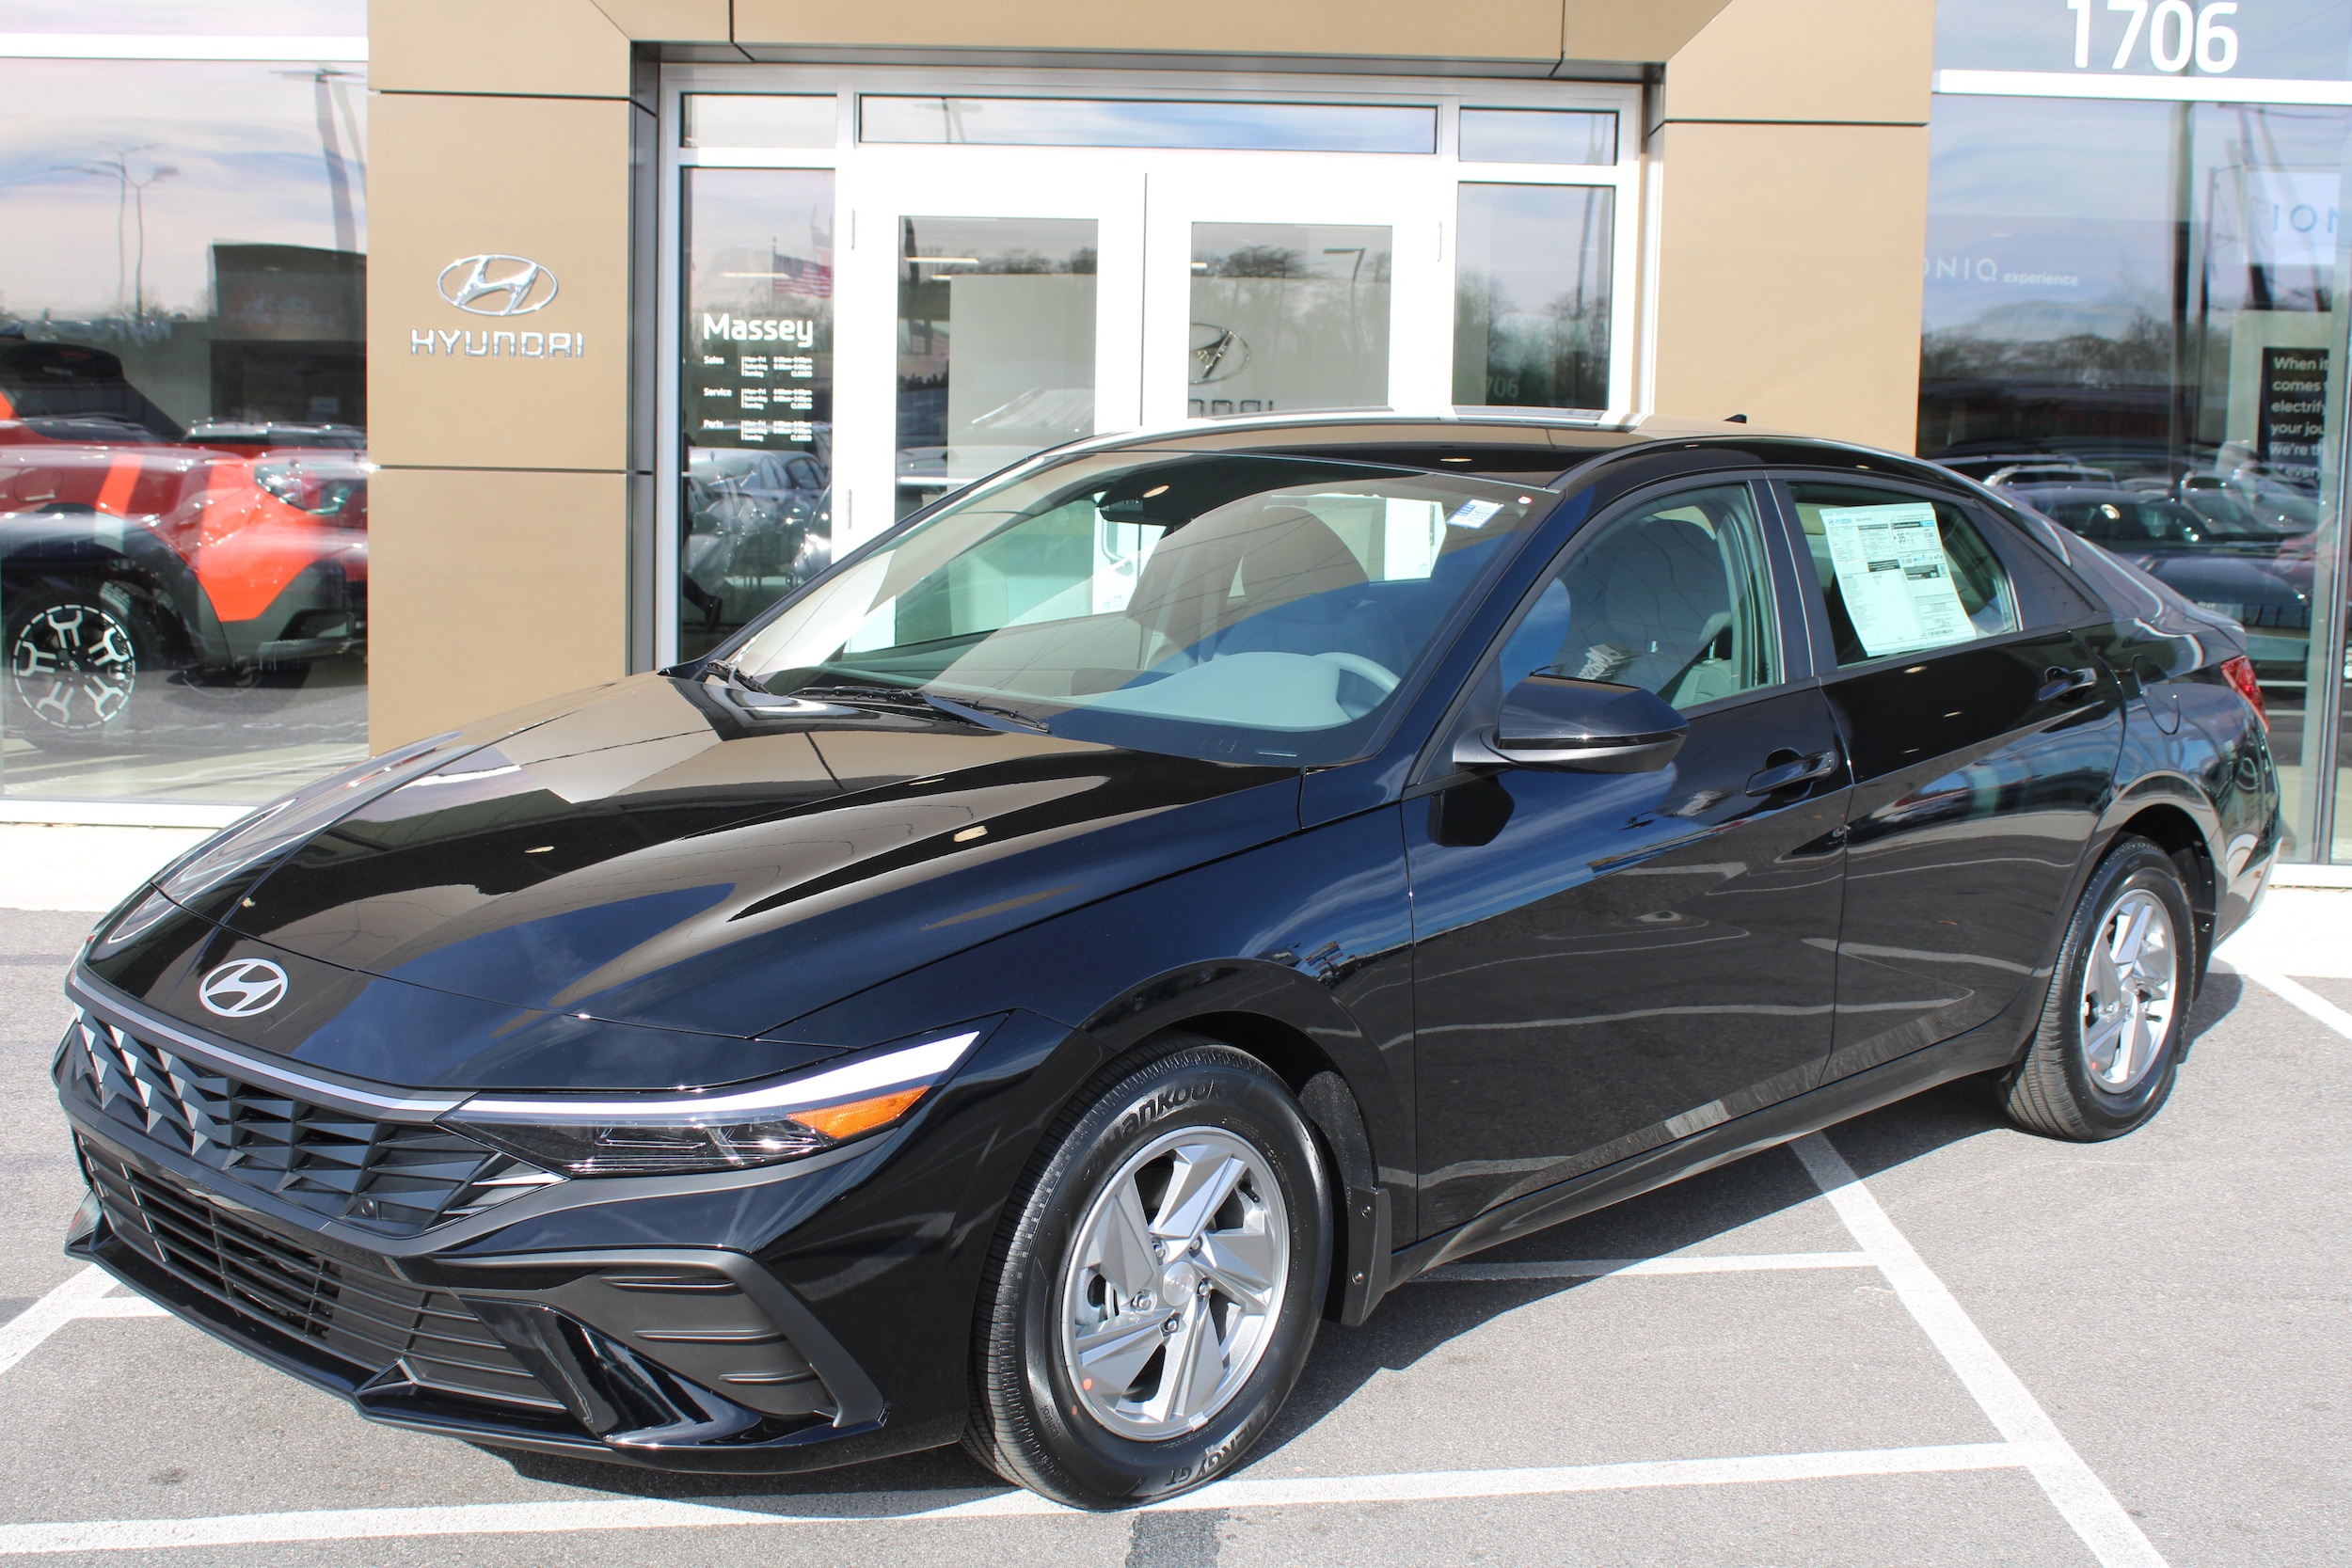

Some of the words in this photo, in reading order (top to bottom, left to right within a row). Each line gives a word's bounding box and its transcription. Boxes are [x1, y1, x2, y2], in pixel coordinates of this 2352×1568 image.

[2067, 0, 2238, 73] 1706
[1924, 257, 1997, 281] NIQ
[2003, 271, 2079, 287] experience
[703, 312, 814, 348] Massey
[411, 328, 584, 359] HYUNDAI
[703, 356, 725, 365] Sales
[2273, 356, 2317, 371] When
[2271, 380, 2322, 391] comes
[703, 388, 733, 397] Service
[703, 420, 724, 429] Parts
[2270, 423, 2303, 436] your
[2269, 443, 2309, 456] we're
